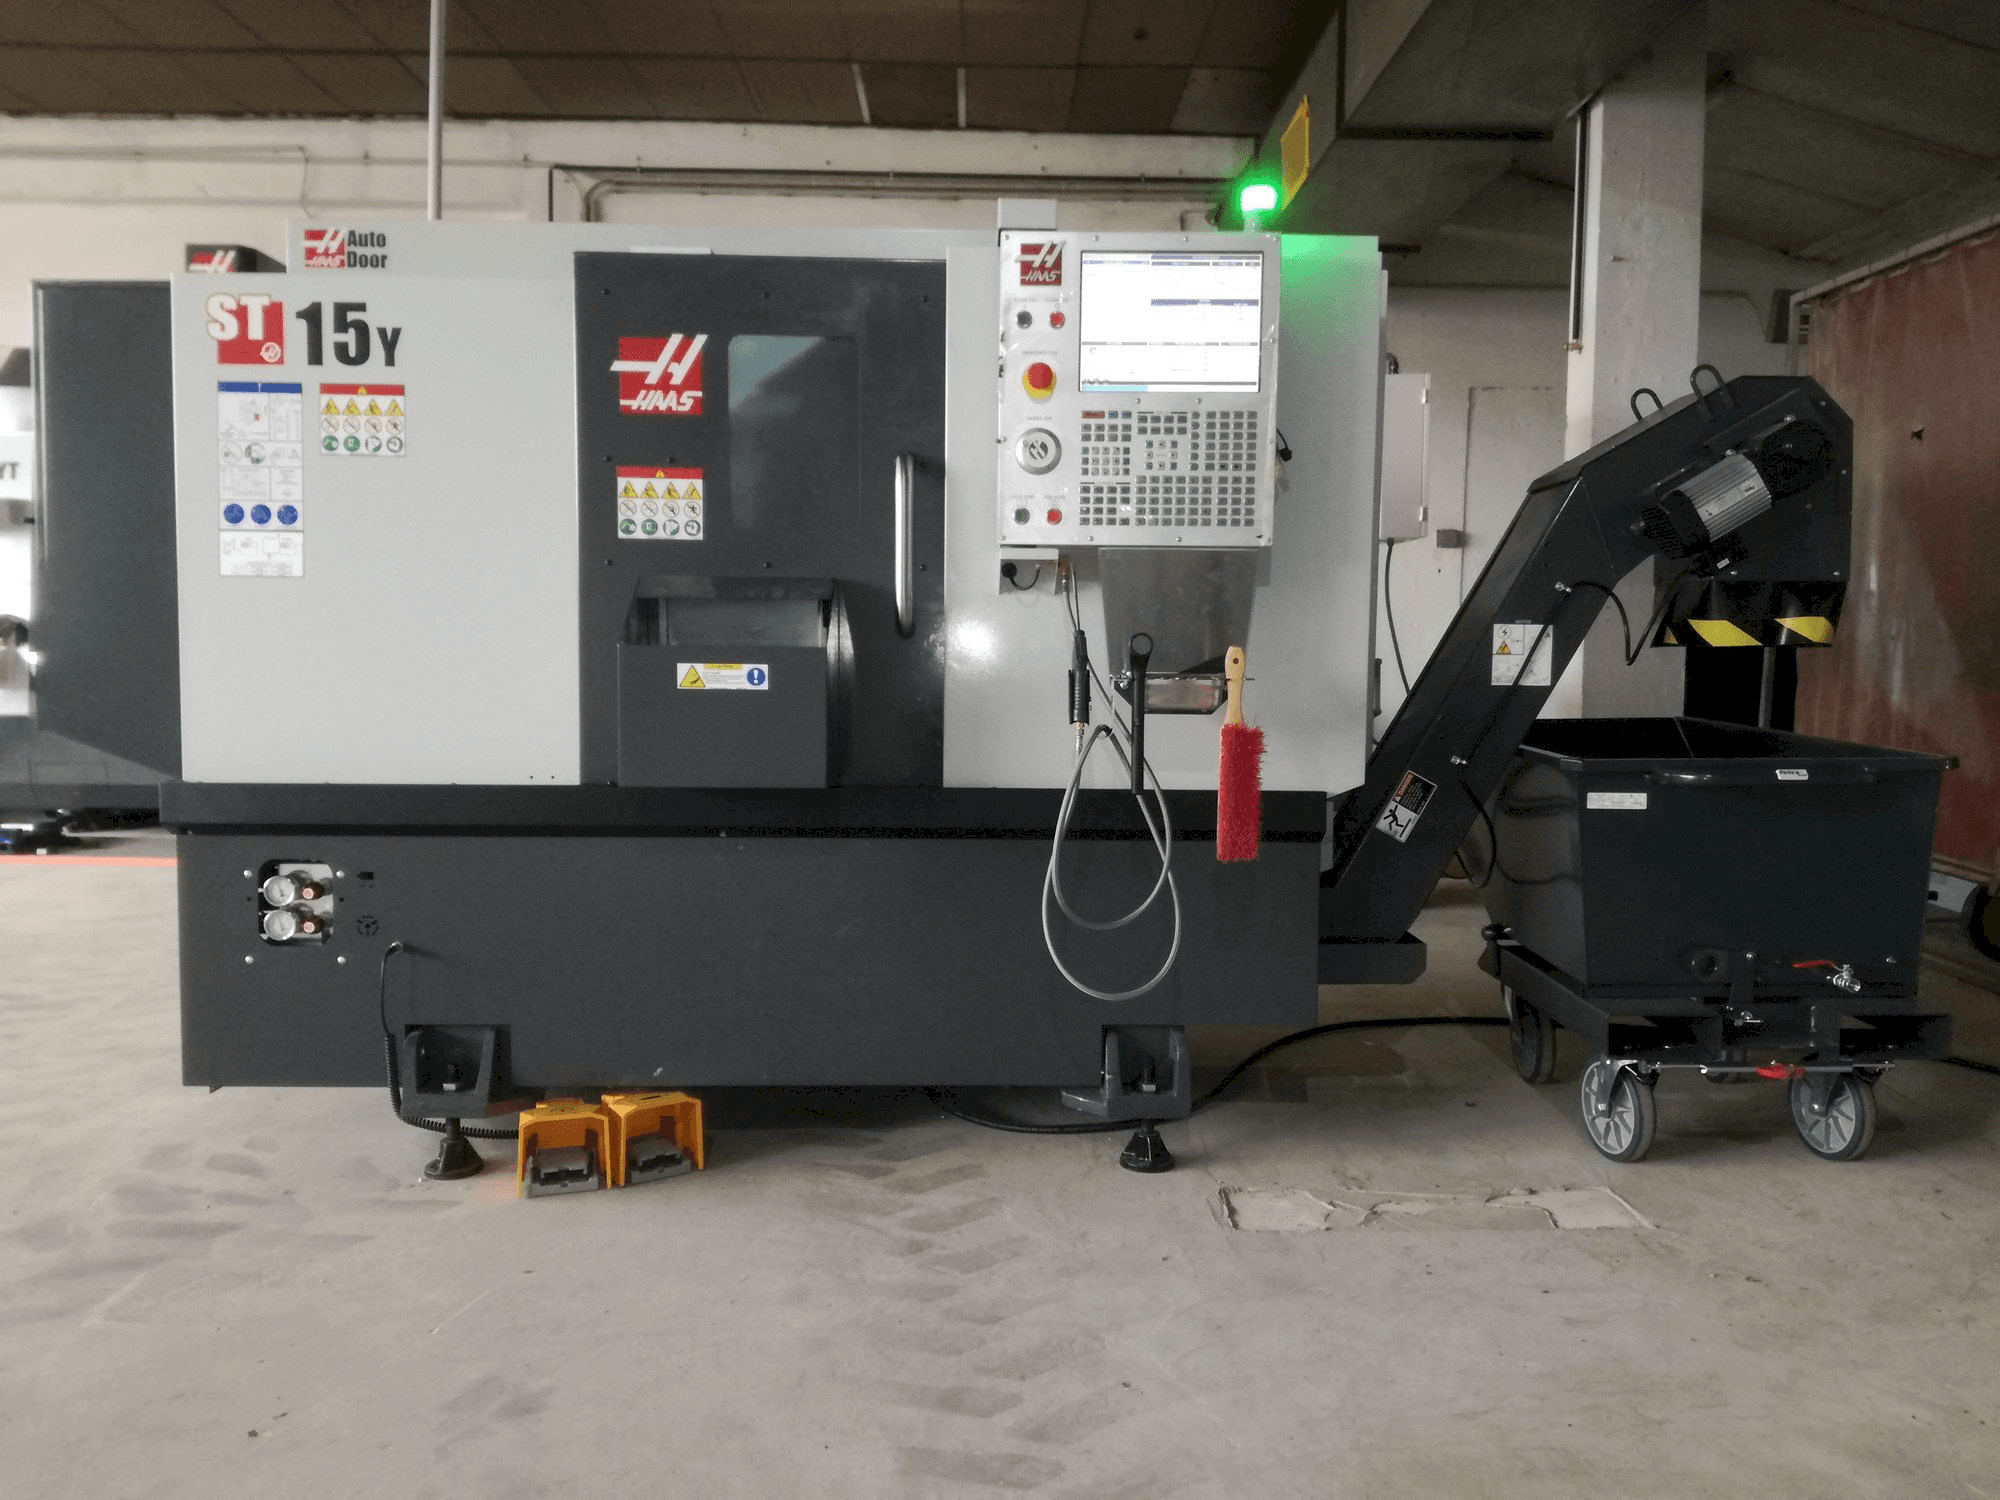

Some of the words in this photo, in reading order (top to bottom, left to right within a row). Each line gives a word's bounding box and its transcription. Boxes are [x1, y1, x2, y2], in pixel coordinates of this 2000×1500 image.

[347, 230, 386, 247] Auto
[347, 251, 387, 268] Door
[1021, 270, 1061, 281] HAAS
[207, 292, 271, 341] ST
[620, 390, 702, 411] HAAS
